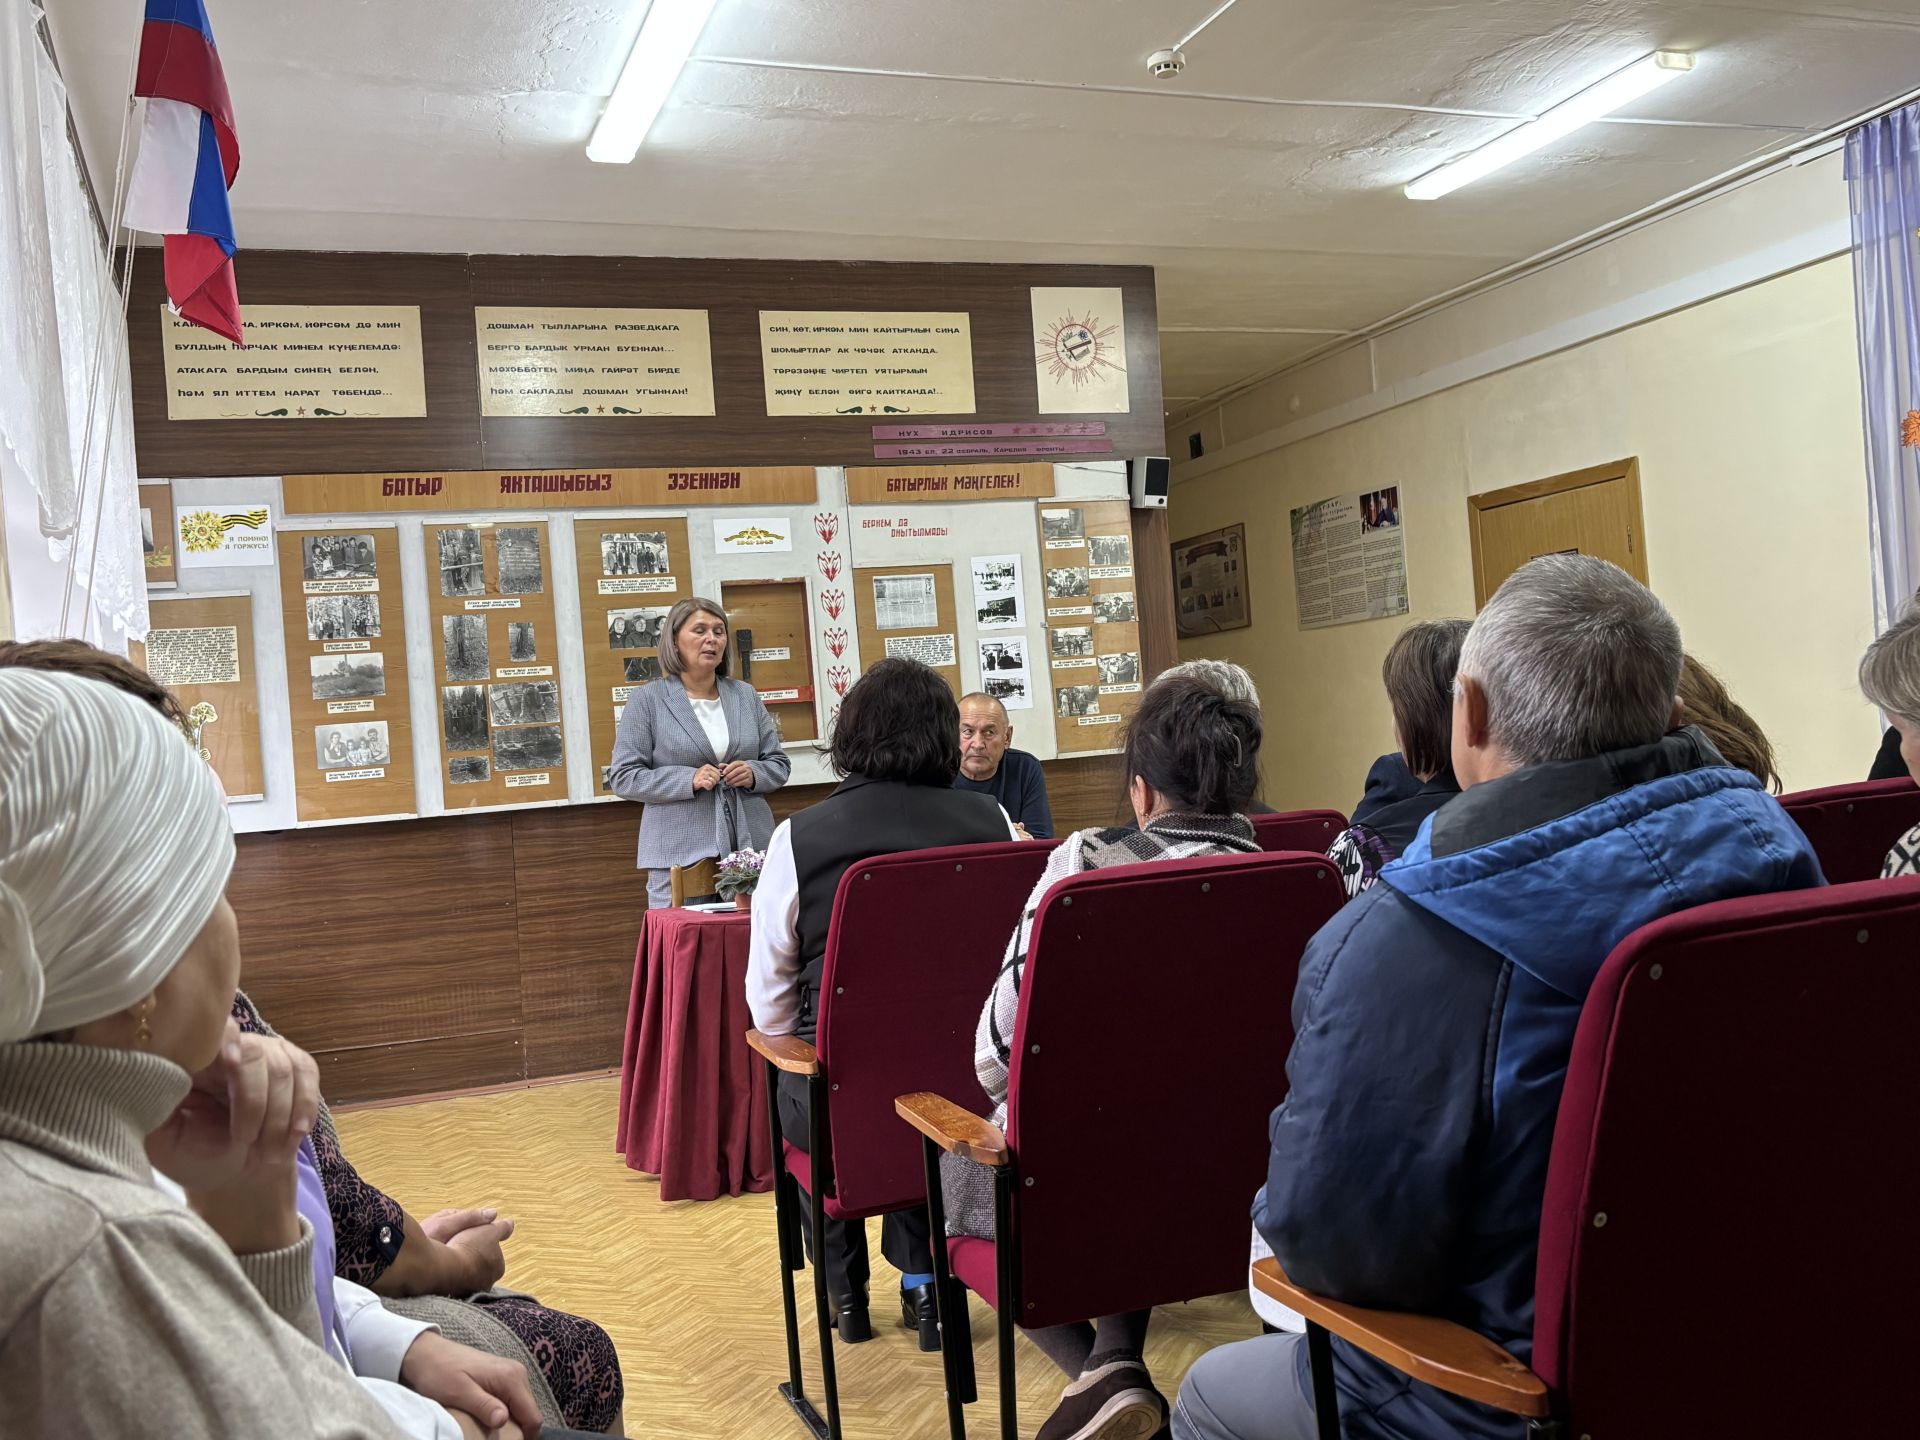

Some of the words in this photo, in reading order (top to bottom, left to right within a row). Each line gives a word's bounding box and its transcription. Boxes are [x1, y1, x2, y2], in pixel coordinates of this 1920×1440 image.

[540, 323, 608, 331] ТЫЛЛАРЫНА
[614, 324, 680, 332] РАЗВЕДКАГА
[524, 344, 568, 352] БАРДЫК
[284, 389, 321, 397] НАРАТ
[519, 388, 574, 396] САКЛАДЫ
[582, 388, 629, 396] ДОШМАН
[635, 387, 688, 395] УГЫННАН!
[898, 429, 920, 438] НУХ
[940, 428, 994, 437] ИДРИСОВ
[898, 448, 922, 456] 1943
[382, 476, 443, 497] БАТЫР
[499, 472, 613, 494] ЯКТАШЫБЫЗ
[886, 476, 949, 493] БАТЫРЛЫК
[862, 518, 892, 529] БЕРКЕМ
[890, 526, 949, 538] ОНЫТЫЛМАДЫ
